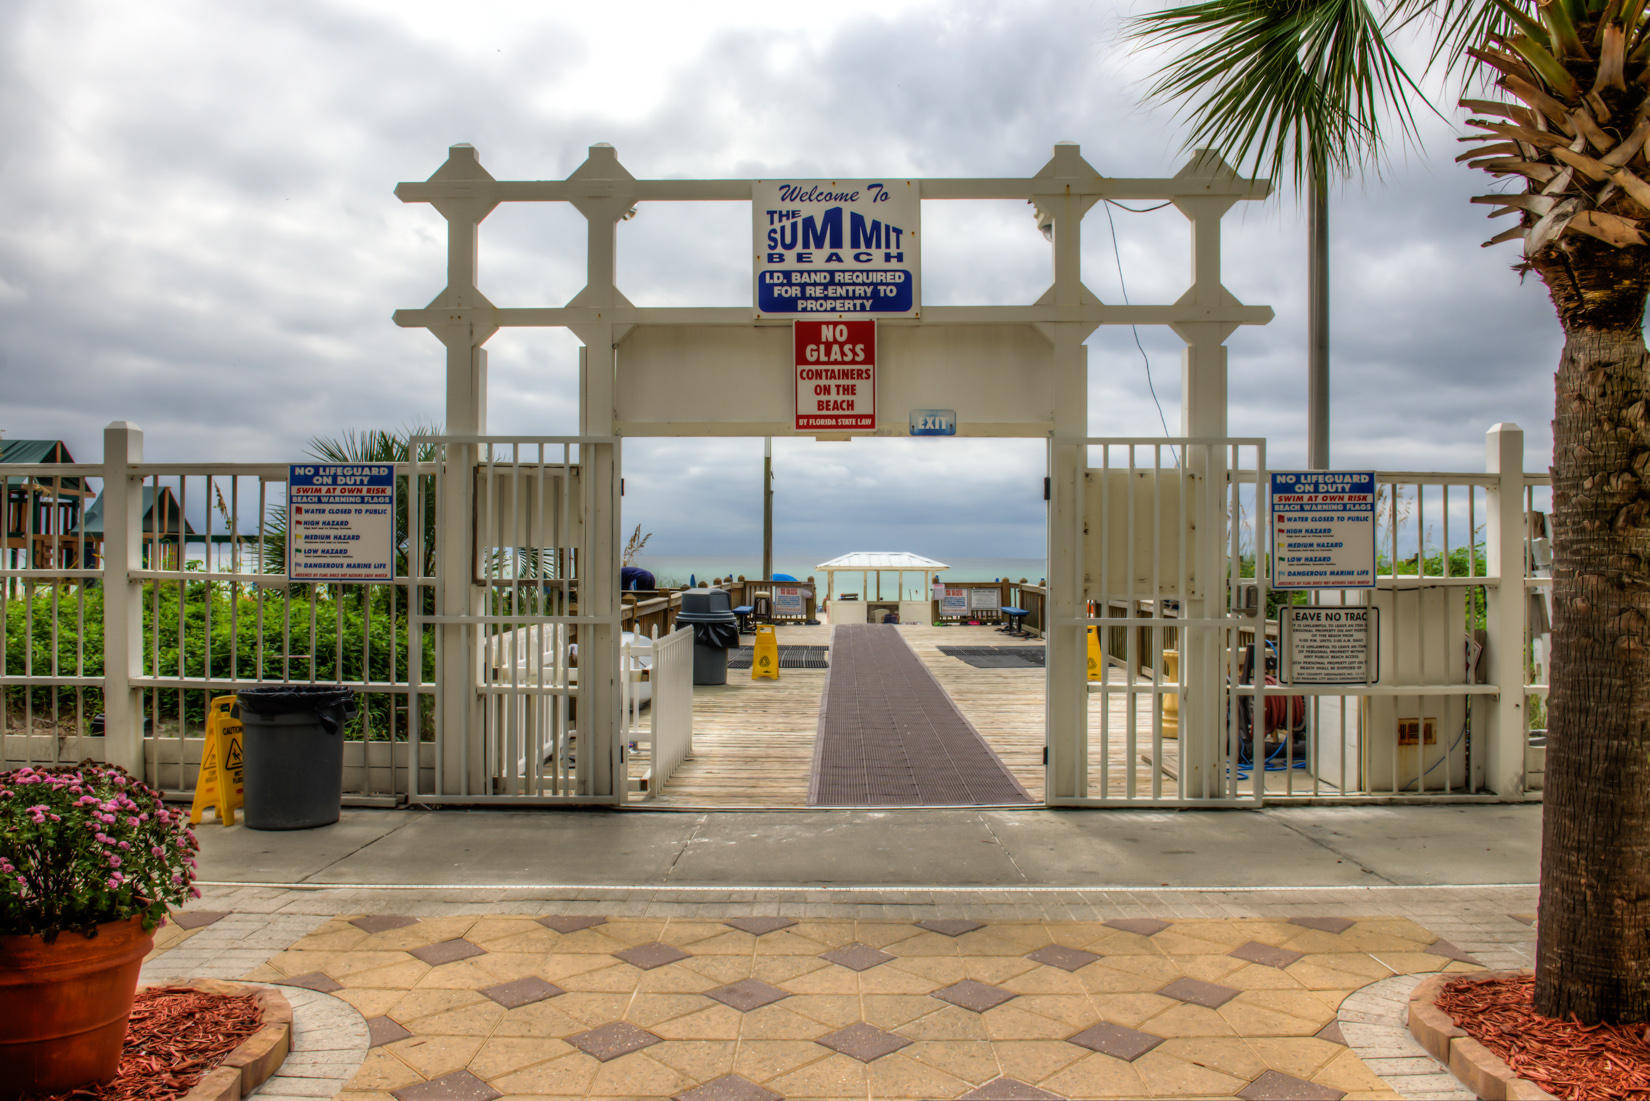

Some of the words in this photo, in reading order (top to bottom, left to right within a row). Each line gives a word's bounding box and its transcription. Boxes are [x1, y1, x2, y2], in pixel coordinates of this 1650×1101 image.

[779, 184, 860, 202] Welcome
[867, 184, 890, 202] To
[766, 210, 801, 225] THE
[767, 206, 903, 250] SUMMIT
[767, 252, 904, 264] BEACH
[766, 272, 787, 284] I.D.
[792, 272, 830, 284] BAND
[834, 272, 904, 284] REQUIRED
[774, 286, 801, 298] FOR
[806, 286, 874, 298] RE-ENTRY
[878, 286, 896, 298] TO
[798, 300, 873, 312] PROPERTY
[821, 324, 848, 342] NO
[806, 344, 865, 362] GLASS
[800, 368, 871, 380] CONTAINERS
[814, 384, 832, 396] ON
[834, 384, 856, 396] THE
[817, 400, 854, 412] BEACH
[918, 416, 947, 430] EXIT
[295, 467, 314, 475] NO
[320, 467, 388, 475] LIFEGUARD
[312, 476, 332, 484] ON
[336, 476, 370, 484] DUTY
[1276, 475, 1296, 483] NO
[1300, 475, 1370, 483] LIFEGUARD
[1295, 484, 1314, 492] ON
[1319, 484, 1352, 492] DUTY
[1292, 612, 1322, 621] EAVE
[1325, 612, 1341, 621] NO
